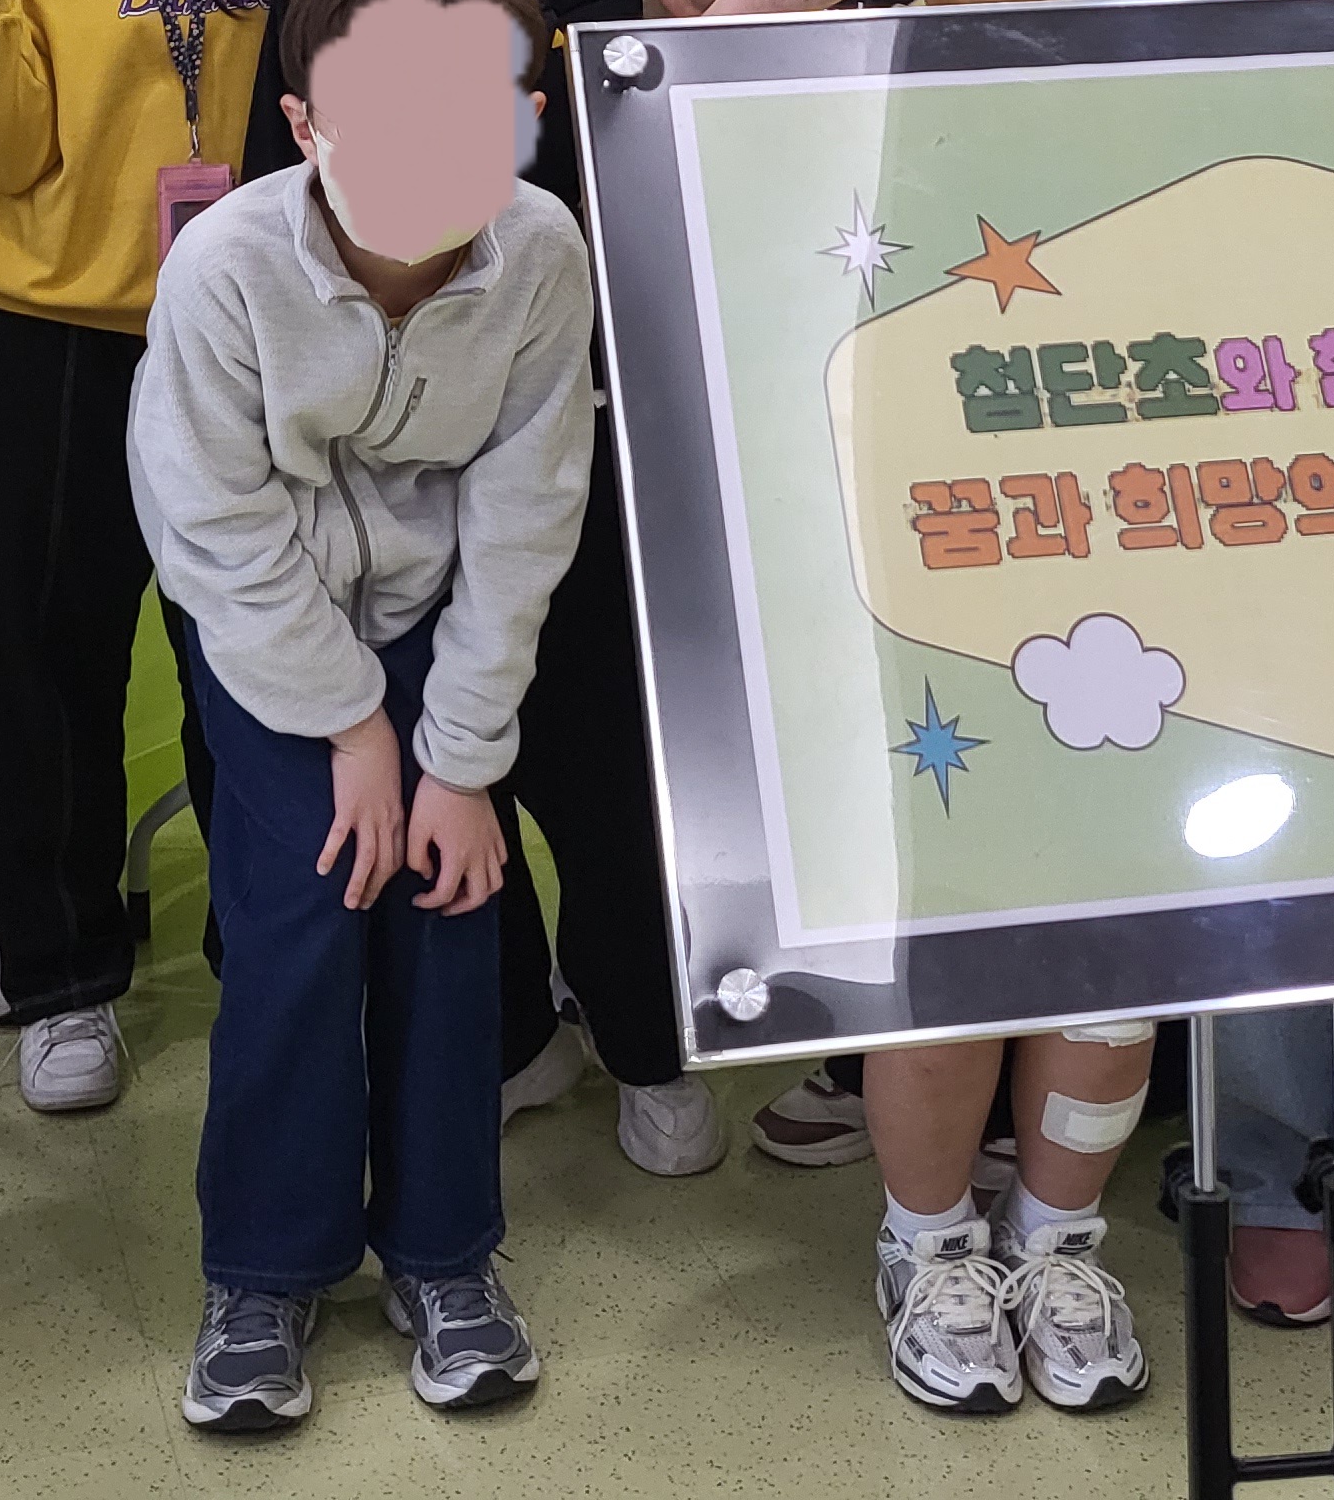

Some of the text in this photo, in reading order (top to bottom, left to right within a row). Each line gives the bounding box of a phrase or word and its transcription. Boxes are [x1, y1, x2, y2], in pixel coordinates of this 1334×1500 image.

[950, 331, 1302, 434] 첨단초와
[907, 471, 1093, 572] 꿈과
[939, 1233, 970, 1253] NIKE
[1061, 1231, 1093, 1246] NIKE
